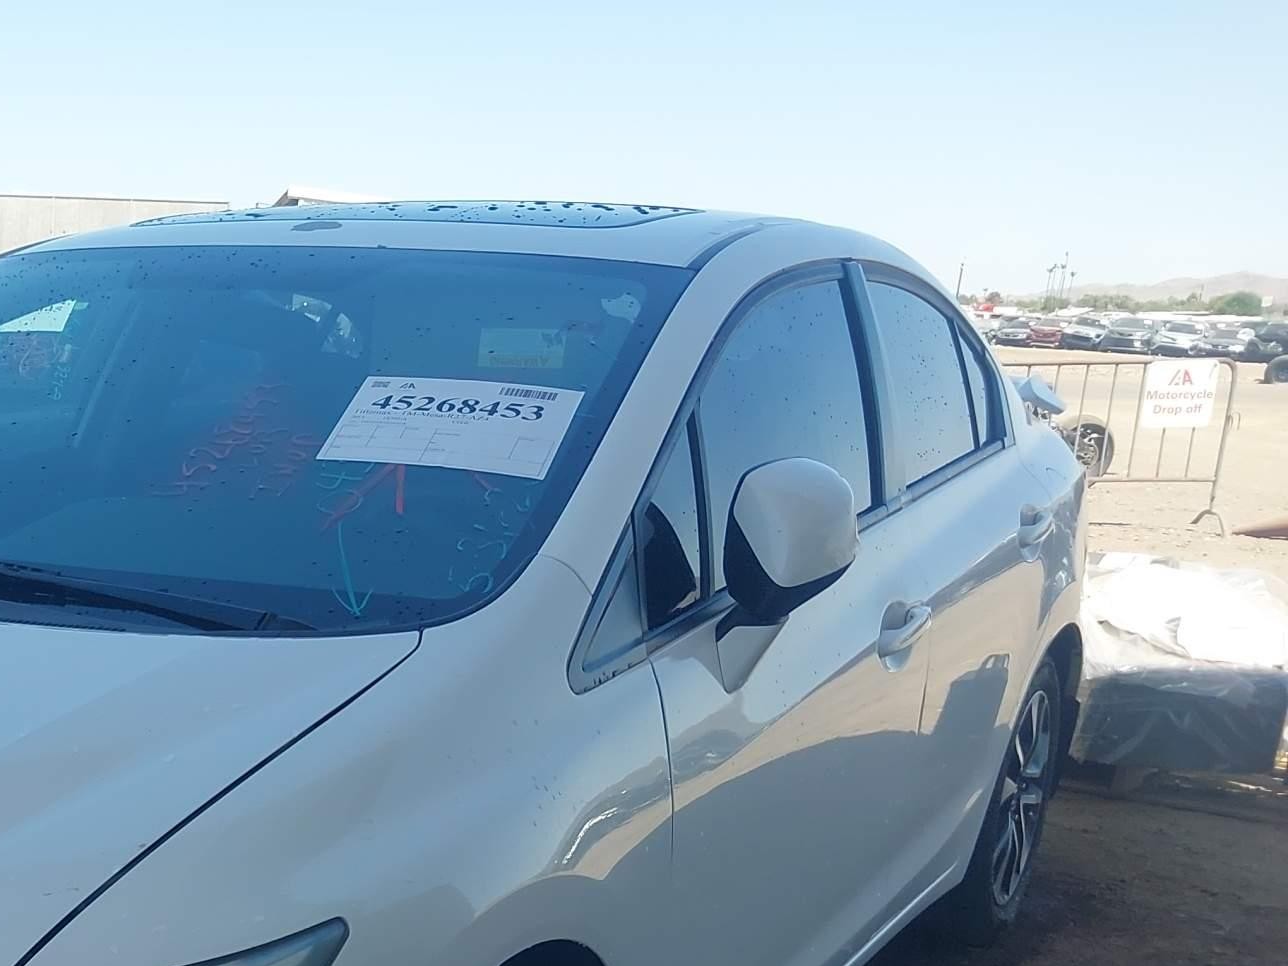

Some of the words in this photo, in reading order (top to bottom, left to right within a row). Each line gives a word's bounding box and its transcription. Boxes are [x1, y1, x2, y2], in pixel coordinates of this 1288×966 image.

[1146, 390, 1213, 400] Motorcycle
[371, 395, 545, 421] 45268453
[1153, 404, 1182, 415] Drop
[1186, 403, 1203, 413] off
